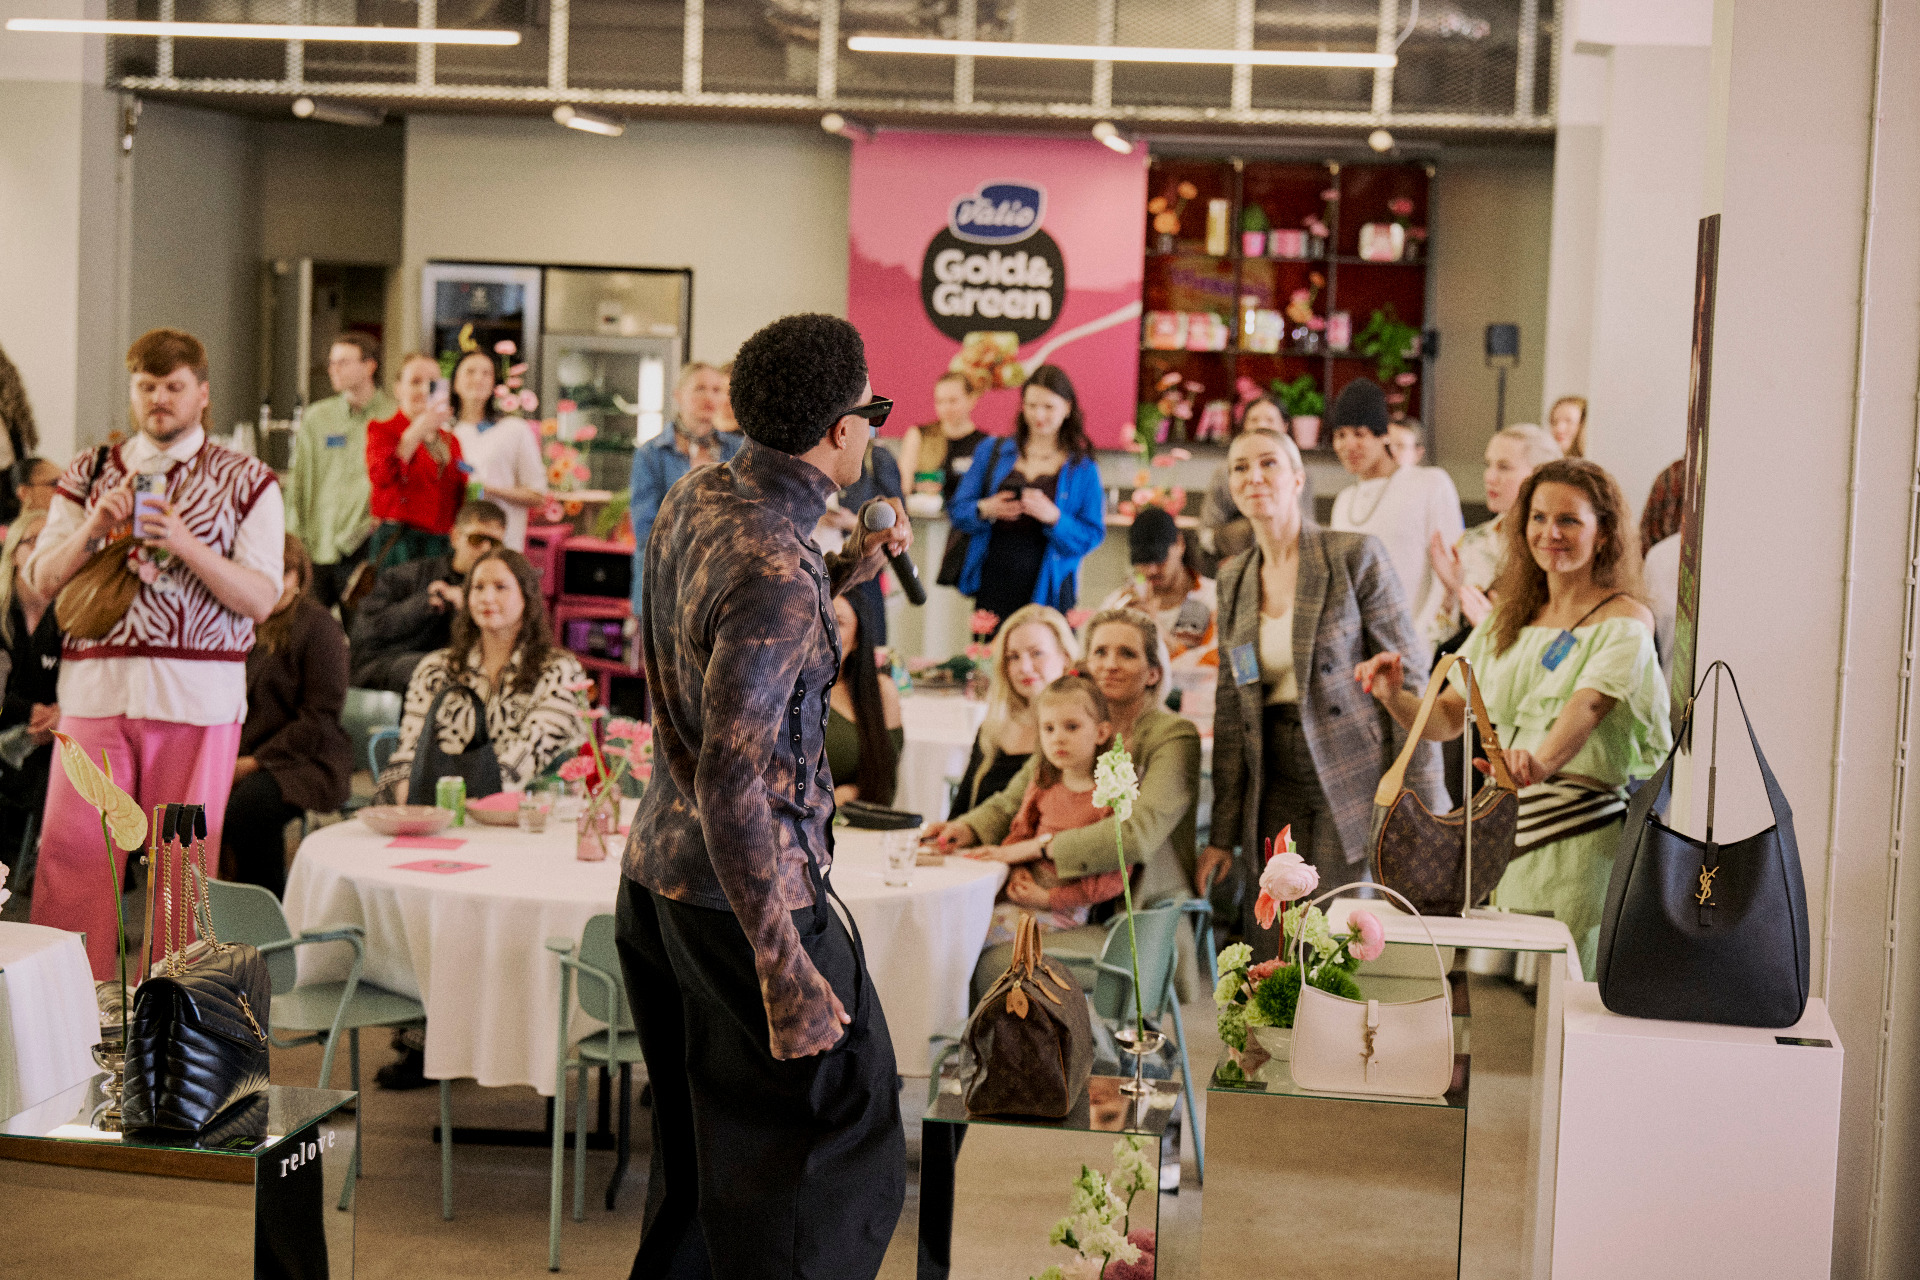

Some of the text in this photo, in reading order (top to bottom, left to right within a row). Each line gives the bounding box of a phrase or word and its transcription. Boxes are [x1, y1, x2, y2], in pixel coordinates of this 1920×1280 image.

[958, 199, 1036, 228] Valio
[932, 283, 1053, 320] Green
[280, 1130, 336, 1178] relove
